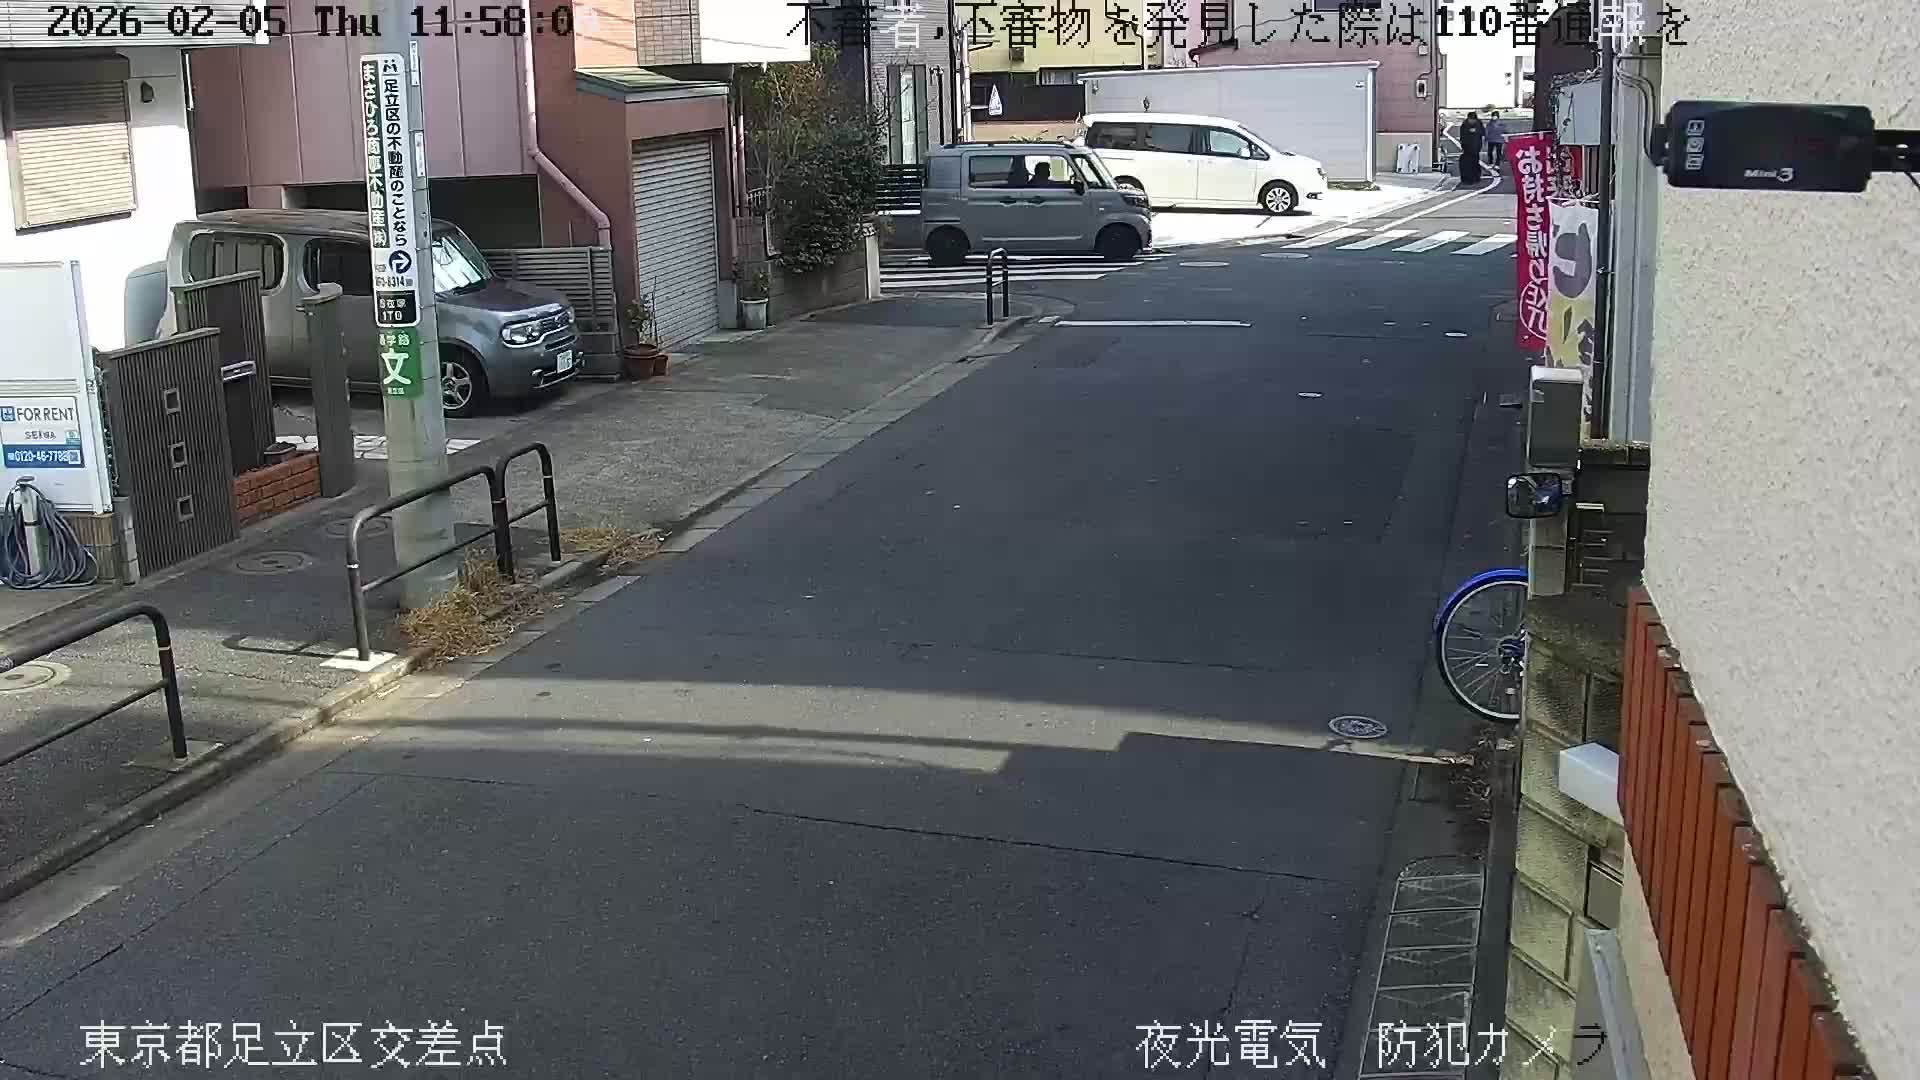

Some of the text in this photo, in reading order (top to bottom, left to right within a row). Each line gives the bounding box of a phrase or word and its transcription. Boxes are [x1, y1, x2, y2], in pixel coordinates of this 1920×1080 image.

[380, 347, 412, 385] 文
[16, 407, 41, 421] FOR
[43, 407, 74, 421] RENT
